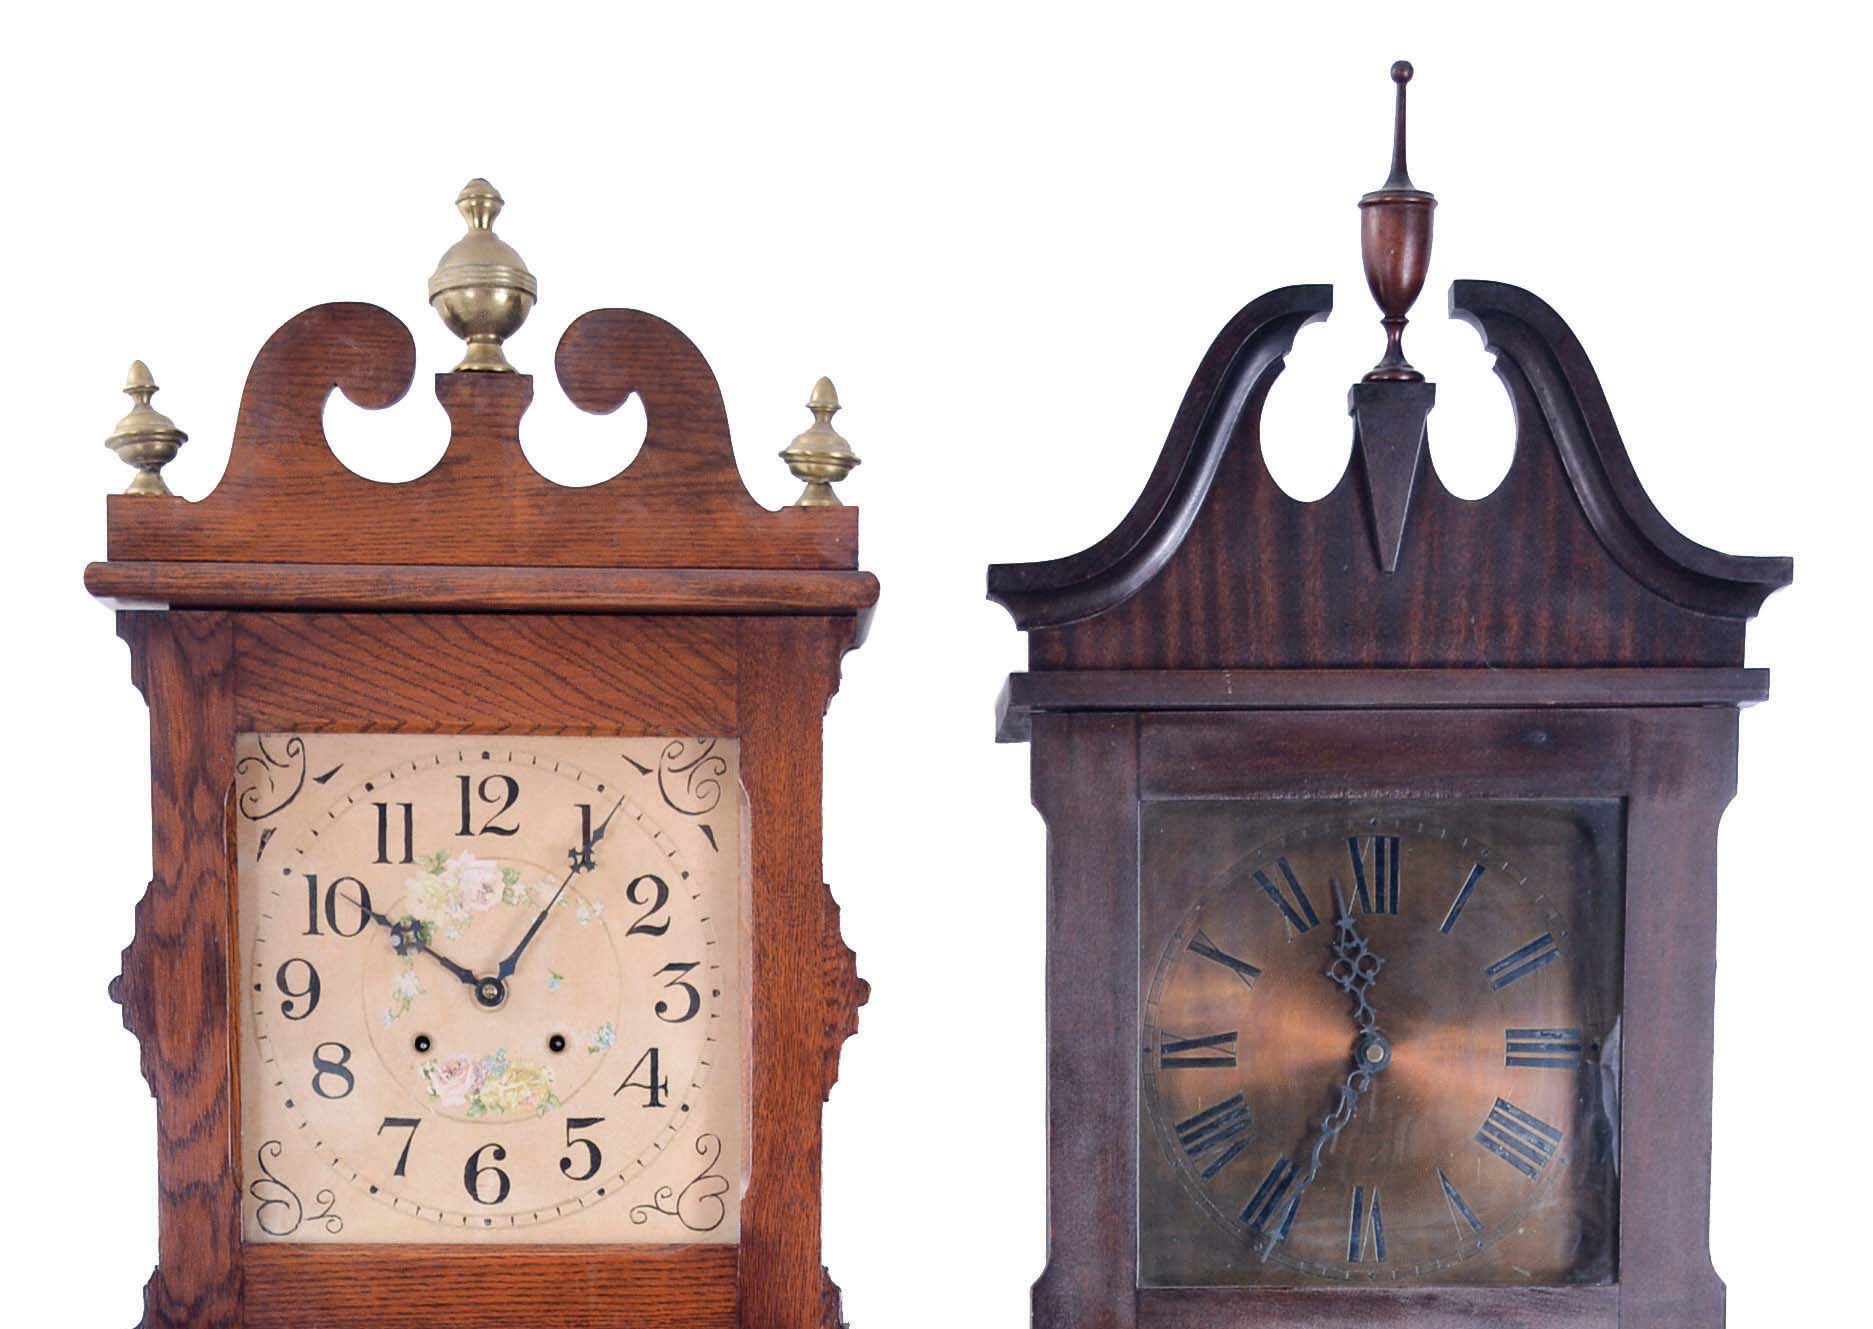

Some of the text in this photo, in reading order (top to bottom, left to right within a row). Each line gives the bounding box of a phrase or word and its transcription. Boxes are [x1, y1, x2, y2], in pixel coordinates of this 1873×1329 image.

[372, 802, 413, 864] 11
[455, 774, 520, 836] 12
[574, 804, 592, 864] 1
[302, 873, 374, 937] 10
[626, 873, 672, 937] 2
[1345, 835, 1400, 915] XII
[1440, 862, 1487, 935] I
[276, 957, 322, 1020] 9
[1187, 928, 1263, 992] X
[1481, 932, 1562, 992] II
[654, 961, 701, 1023] 3
[311, 1041, 355, 1099] 8
[613, 1047, 669, 1109] 4
[1160, 1030, 1238, 1070] IX
[1504, 1028, 1584, 1069] III
[377, 1117, 421, 1177] 7
[463, 1143, 511, 1205] 6
[559, 1117, 606, 1181] 5
[1347, 1184, 1388, 1264] VI
